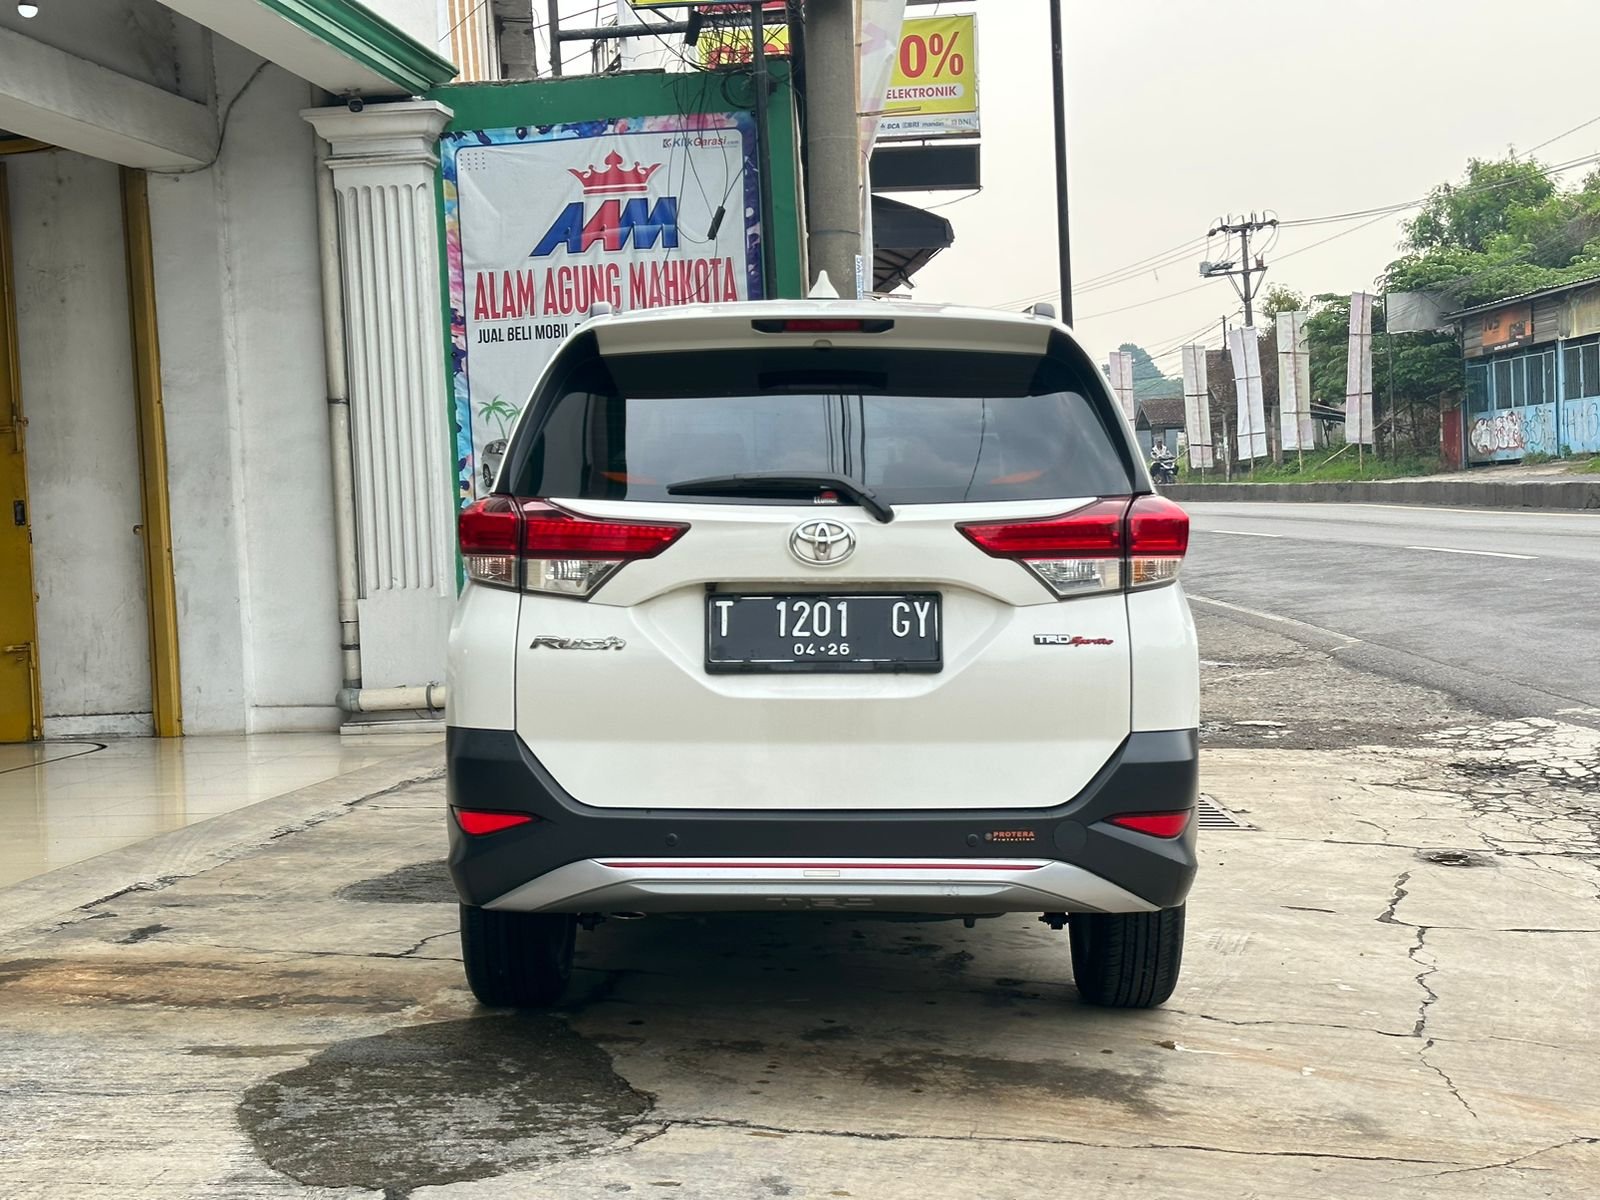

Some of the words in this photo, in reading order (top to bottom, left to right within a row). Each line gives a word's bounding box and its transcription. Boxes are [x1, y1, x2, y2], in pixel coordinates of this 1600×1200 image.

[899, 31, 964, 79] 0%
[886, 86, 957, 99] ELEKTRONIK
[529, 197, 678, 257] AAM
[474, 270, 536, 321] ALAM
[543, 262, 622, 316] AGUNG
[629, 256, 738, 310] MAHKOTA
[477, 326, 505, 344] JUAL
[507, 325, 532, 341] BELI
[715, 600, 734, 637] T
[776, 600, 849, 638] 1201
[892, 600, 931, 638] GY
[1033, 634, 1071, 645] TRD
